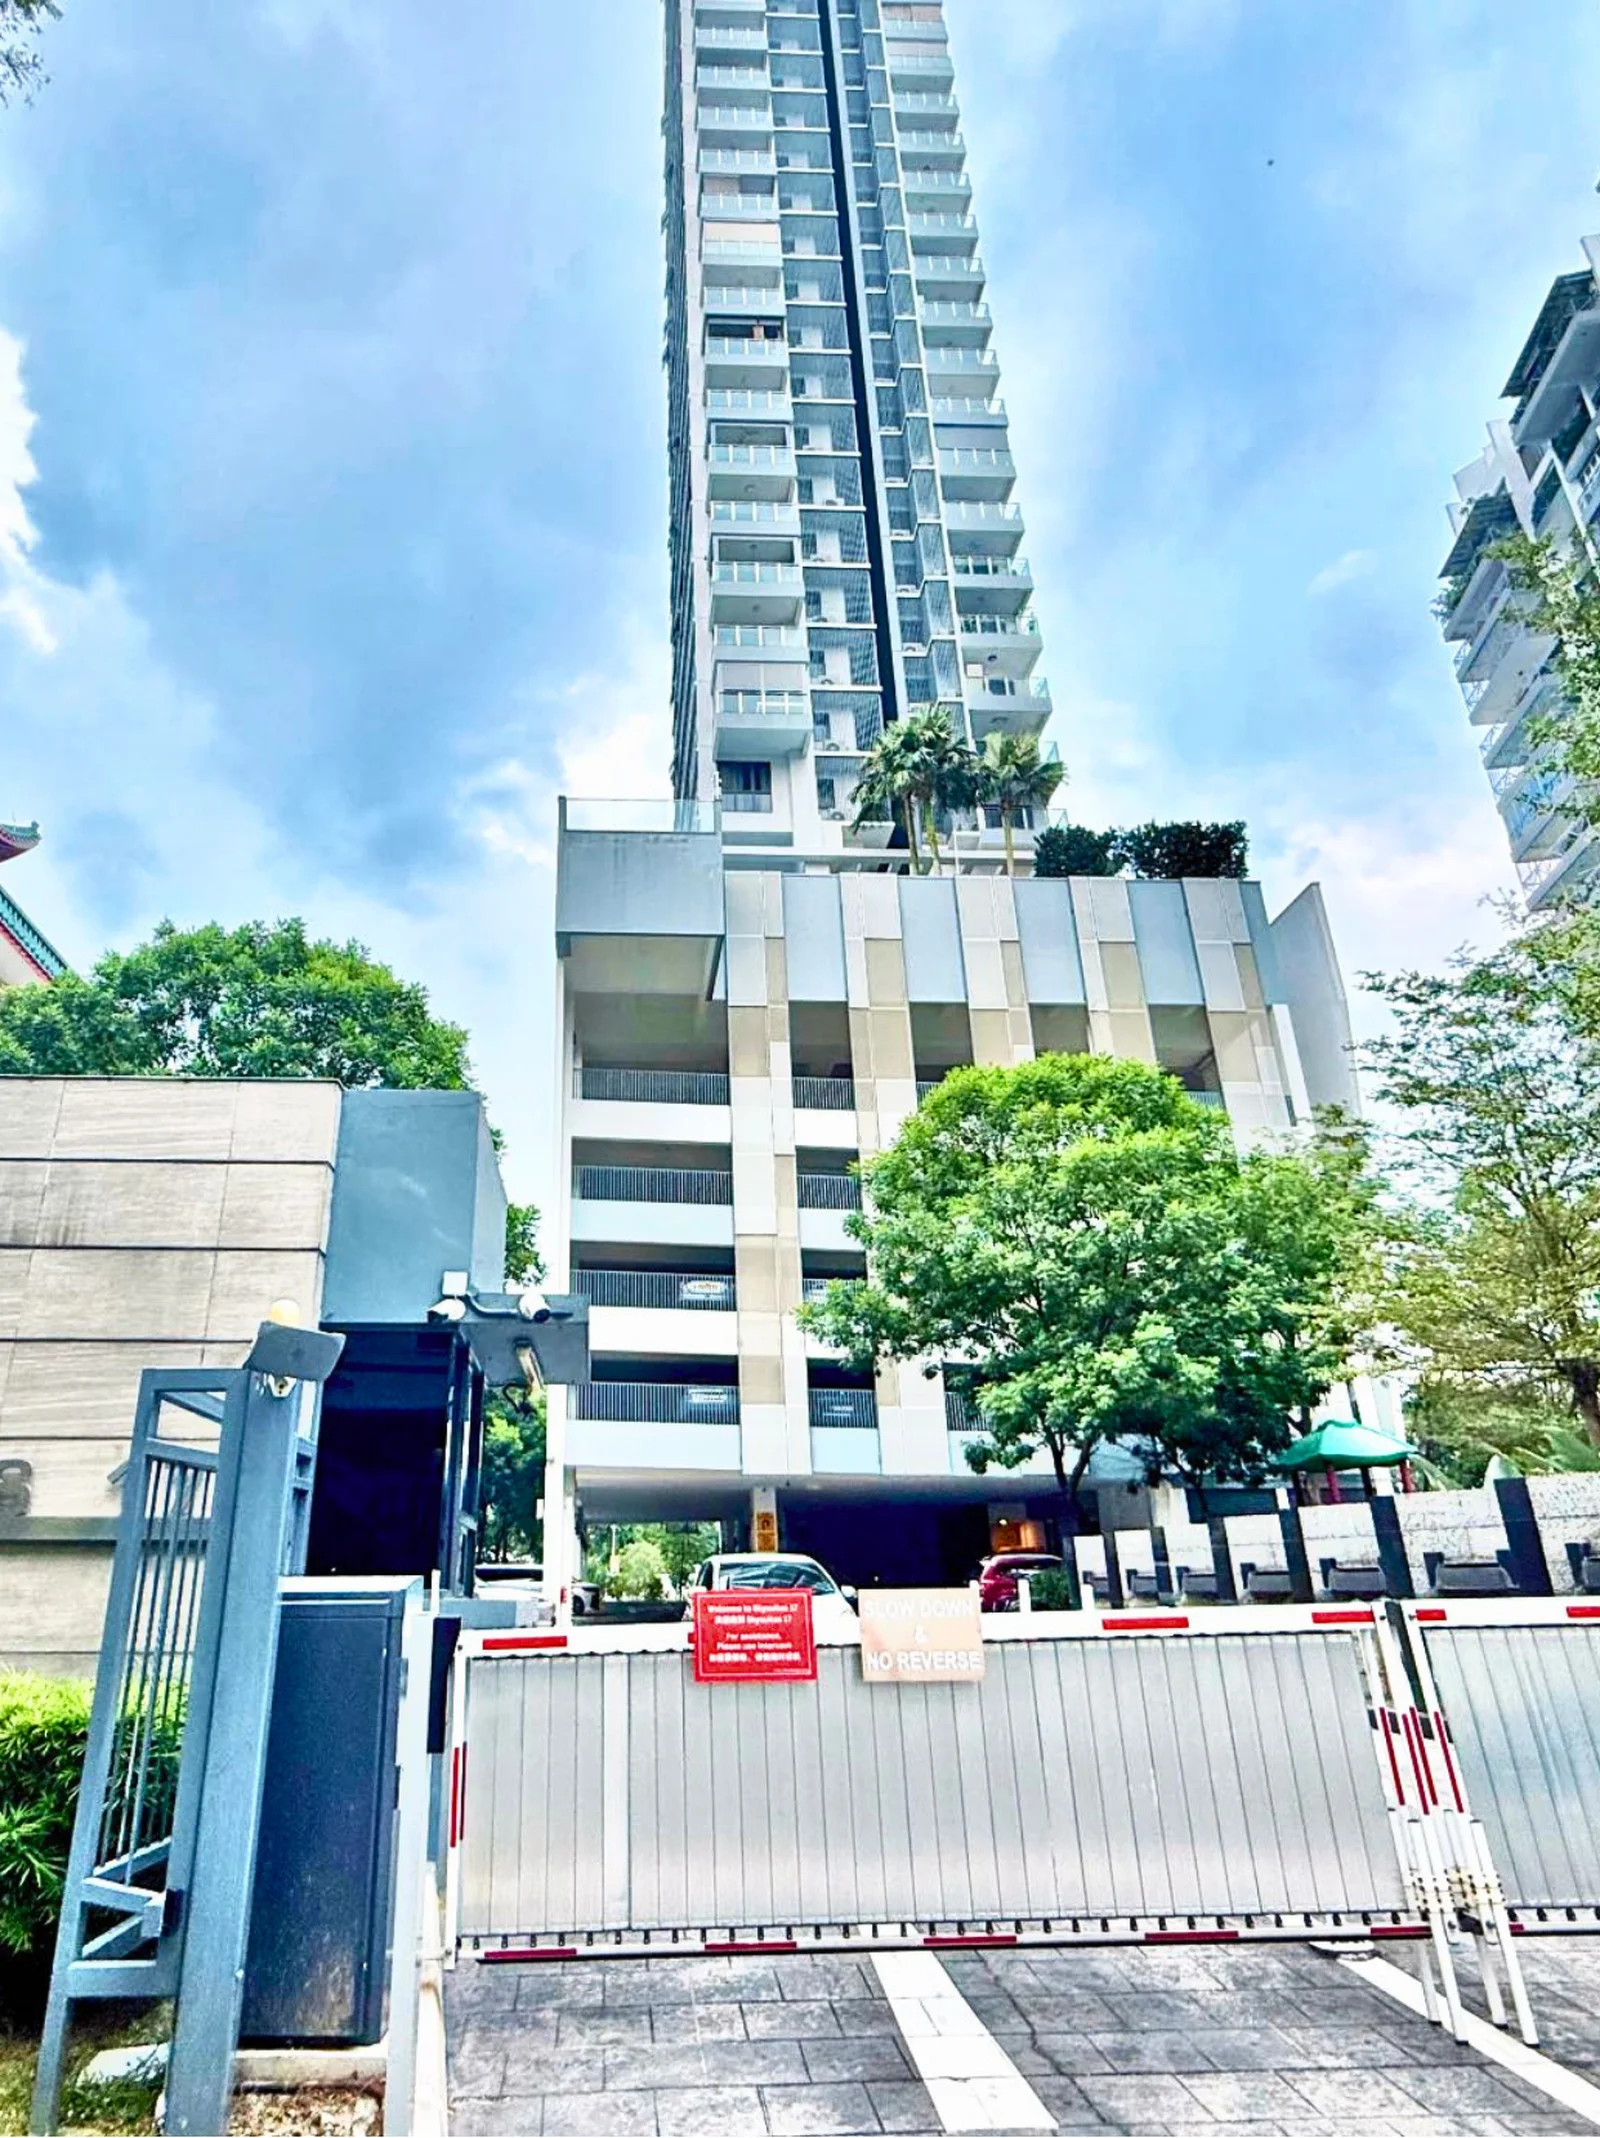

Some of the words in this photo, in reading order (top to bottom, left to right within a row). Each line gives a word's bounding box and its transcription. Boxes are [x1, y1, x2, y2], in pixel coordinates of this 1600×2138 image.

[864, 1598, 914, 1618] SLOW
[919, 1598, 972, 1617] DOWN
[866, 1651, 892, 1671] NO
[898, 1651, 982, 1671] REVERSE
